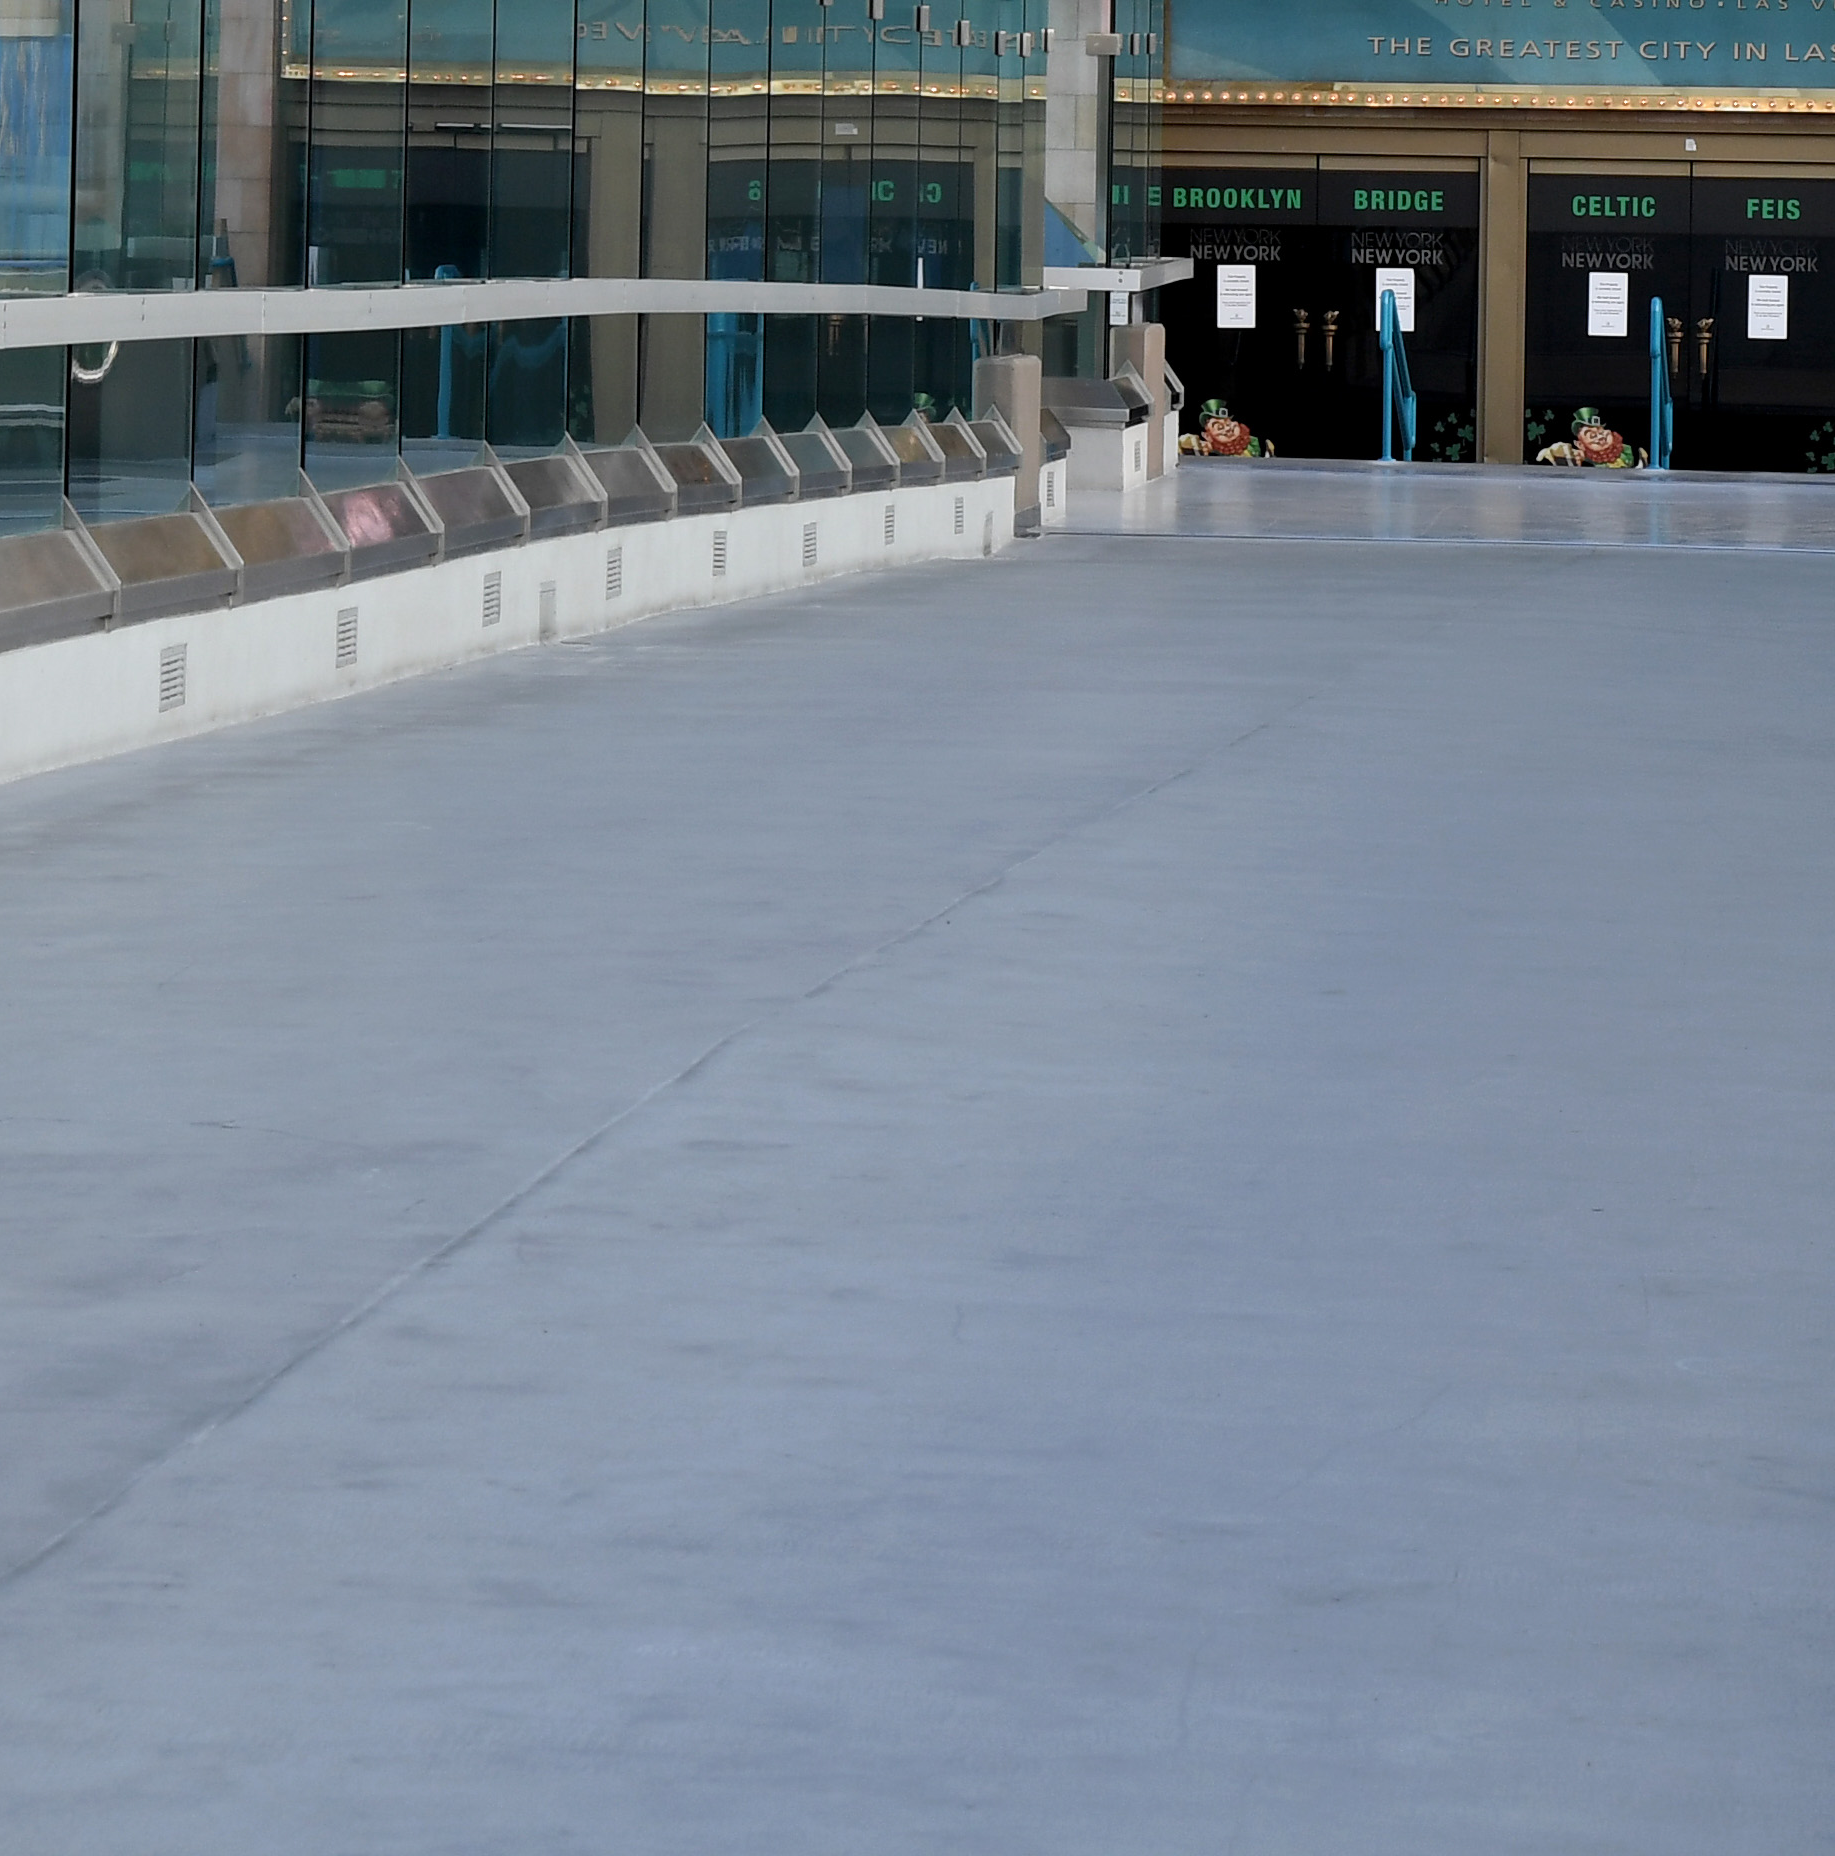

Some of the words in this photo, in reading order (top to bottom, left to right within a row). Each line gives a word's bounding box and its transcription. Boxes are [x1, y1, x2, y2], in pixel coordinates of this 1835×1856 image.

[1367, 36, 1433, 56] THE
[1449, 38, 1626, 61] GREATEST
[1639, 40, 1716, 61] CITY
[1732, 41, 1767, 62] IN
[1172, 187, 1302, 210] BROOKLYN
[1353, 190, 1445, 212] BRIDGE
[1572, 195, 1657, 217] CELTIC
[1746, 198, 1801, 220] FEIS
[1190, 245, 1232, 261] NEW
[1232, 245, 1282, 261] YORK
[1351, 249, 1394, 265] NEW
[1394, 249, 1444, 265] YORK
[1562, 252, 1603, 269] NEW
[1606, 252, 1654, 269] YORK
[1725, 256, 1766, 272] NEW
[1769, 256, 1818, 272] YORK
